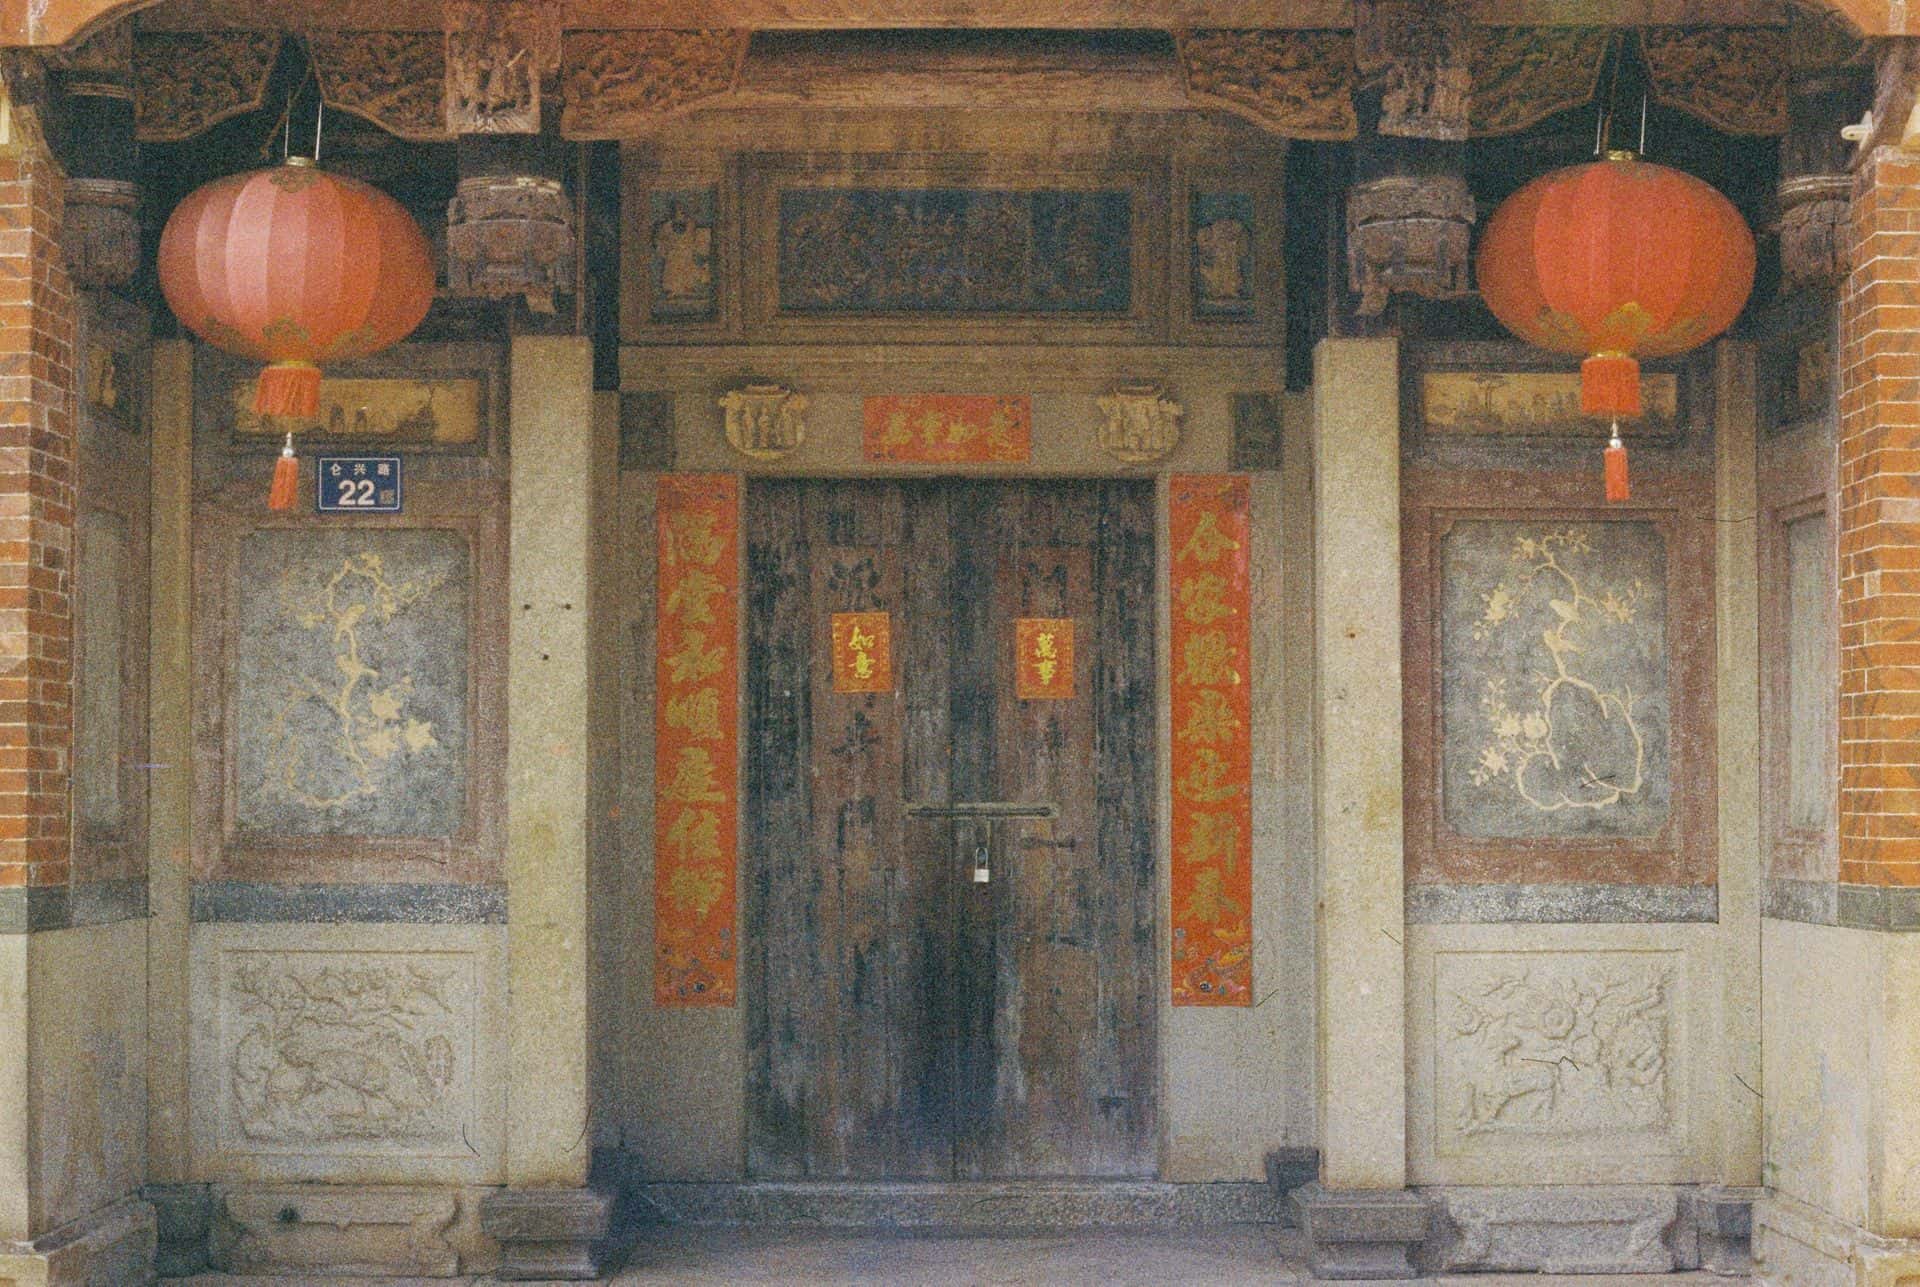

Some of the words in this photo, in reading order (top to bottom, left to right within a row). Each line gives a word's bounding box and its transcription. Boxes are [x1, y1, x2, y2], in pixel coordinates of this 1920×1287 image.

[338, 479, 375, 506] 22
[848, 625, 876, 679] 如意
[1034, 632, 1058, 685] 萬事
